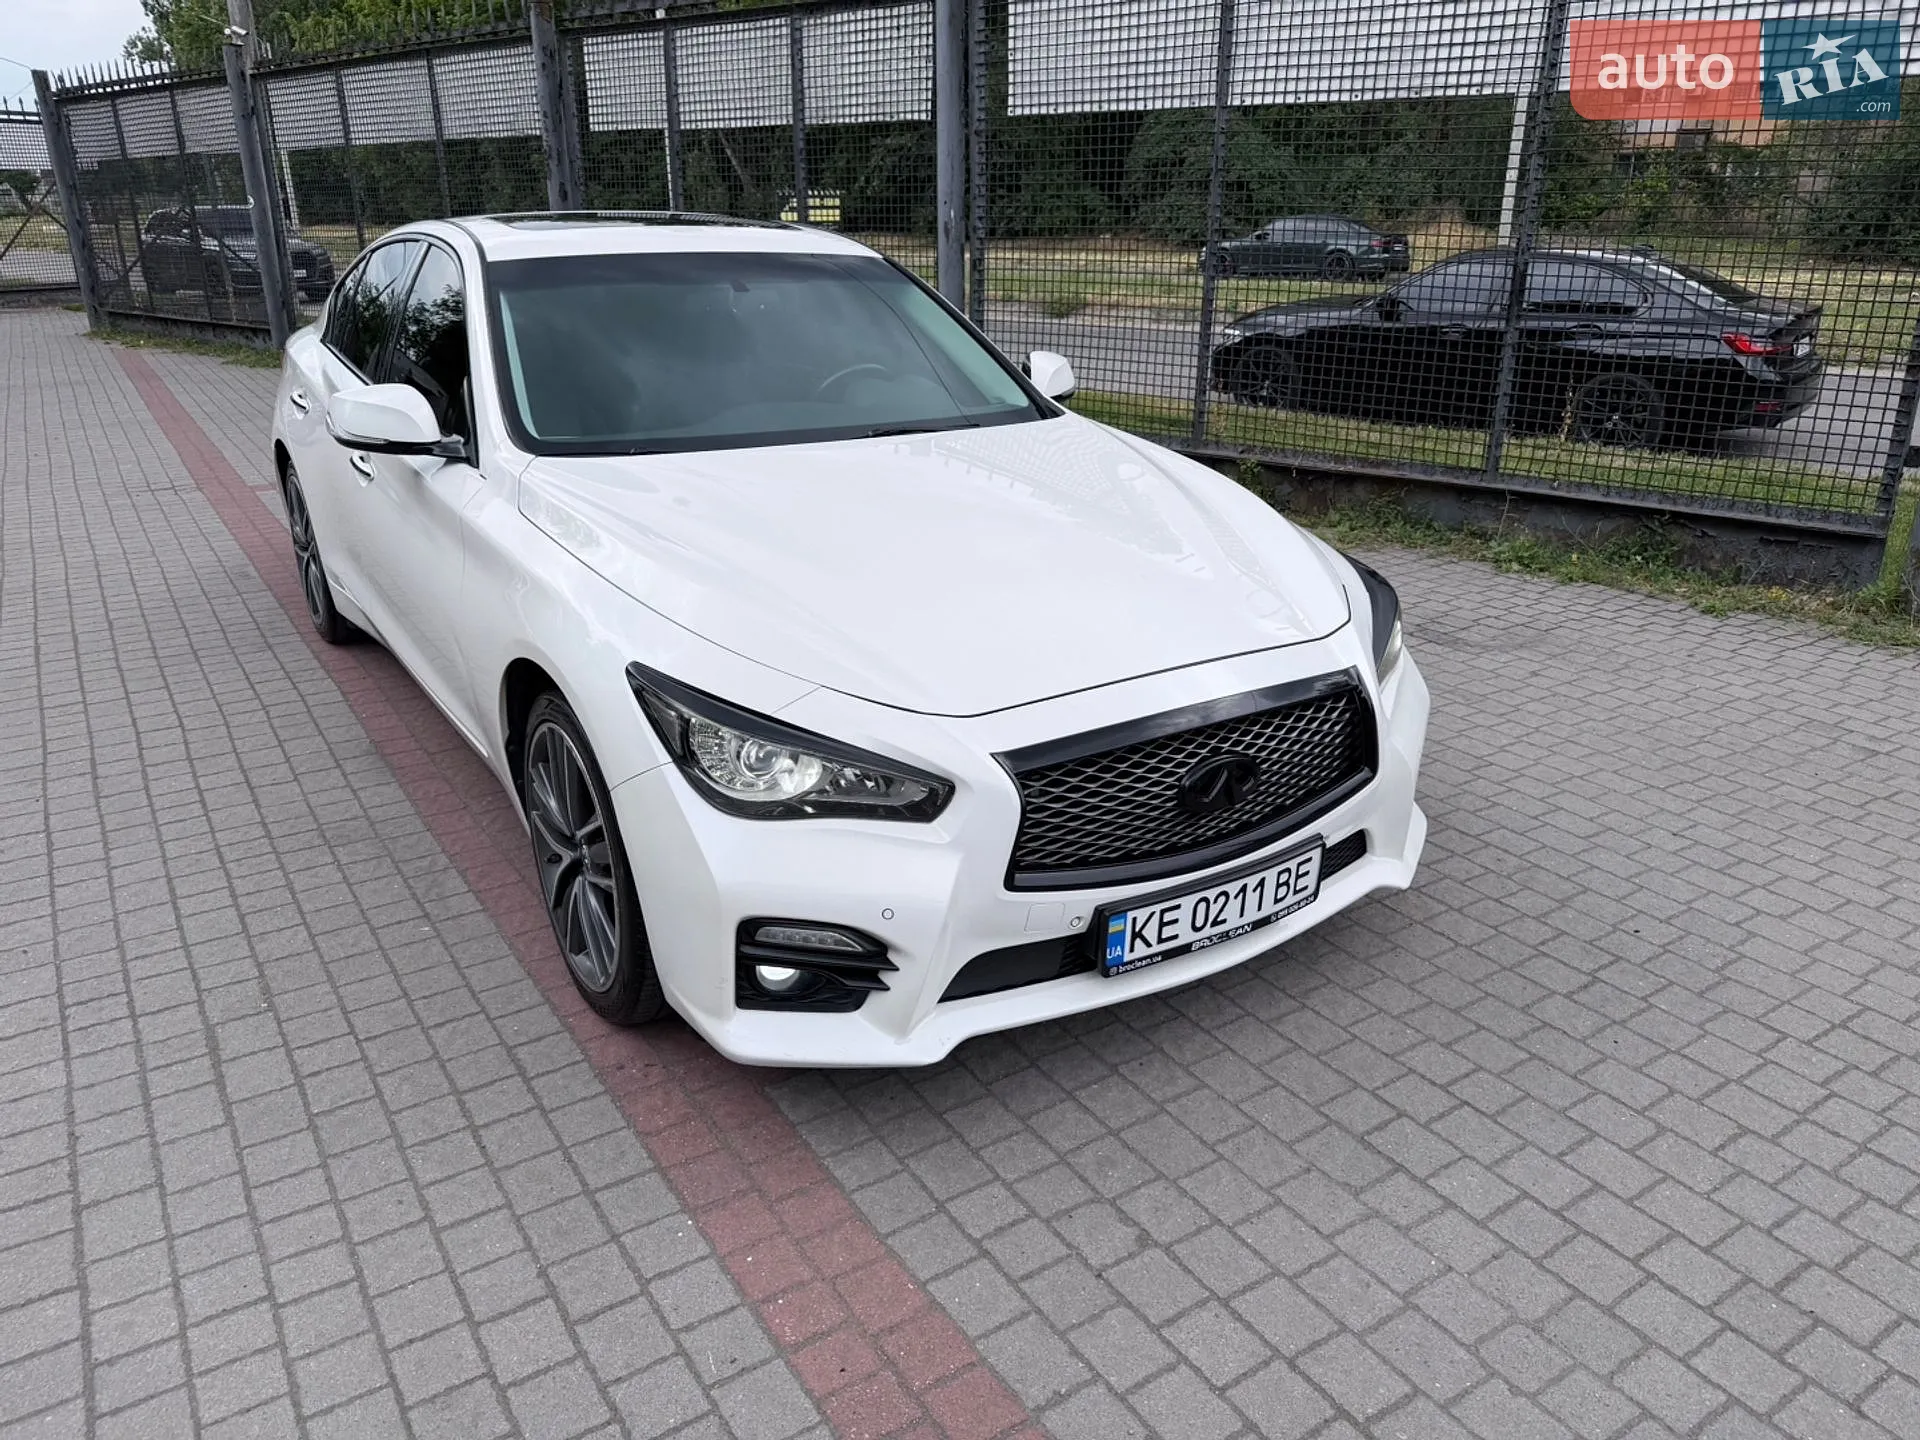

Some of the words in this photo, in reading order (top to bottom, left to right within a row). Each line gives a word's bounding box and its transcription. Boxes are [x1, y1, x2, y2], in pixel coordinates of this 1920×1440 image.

[1129, 903, 1182, 953] KE
[1190, 876, 1267, 933] 0211
[1273, 856, 1313, 905] BE
[1106, 945, 1122, 959] UA
